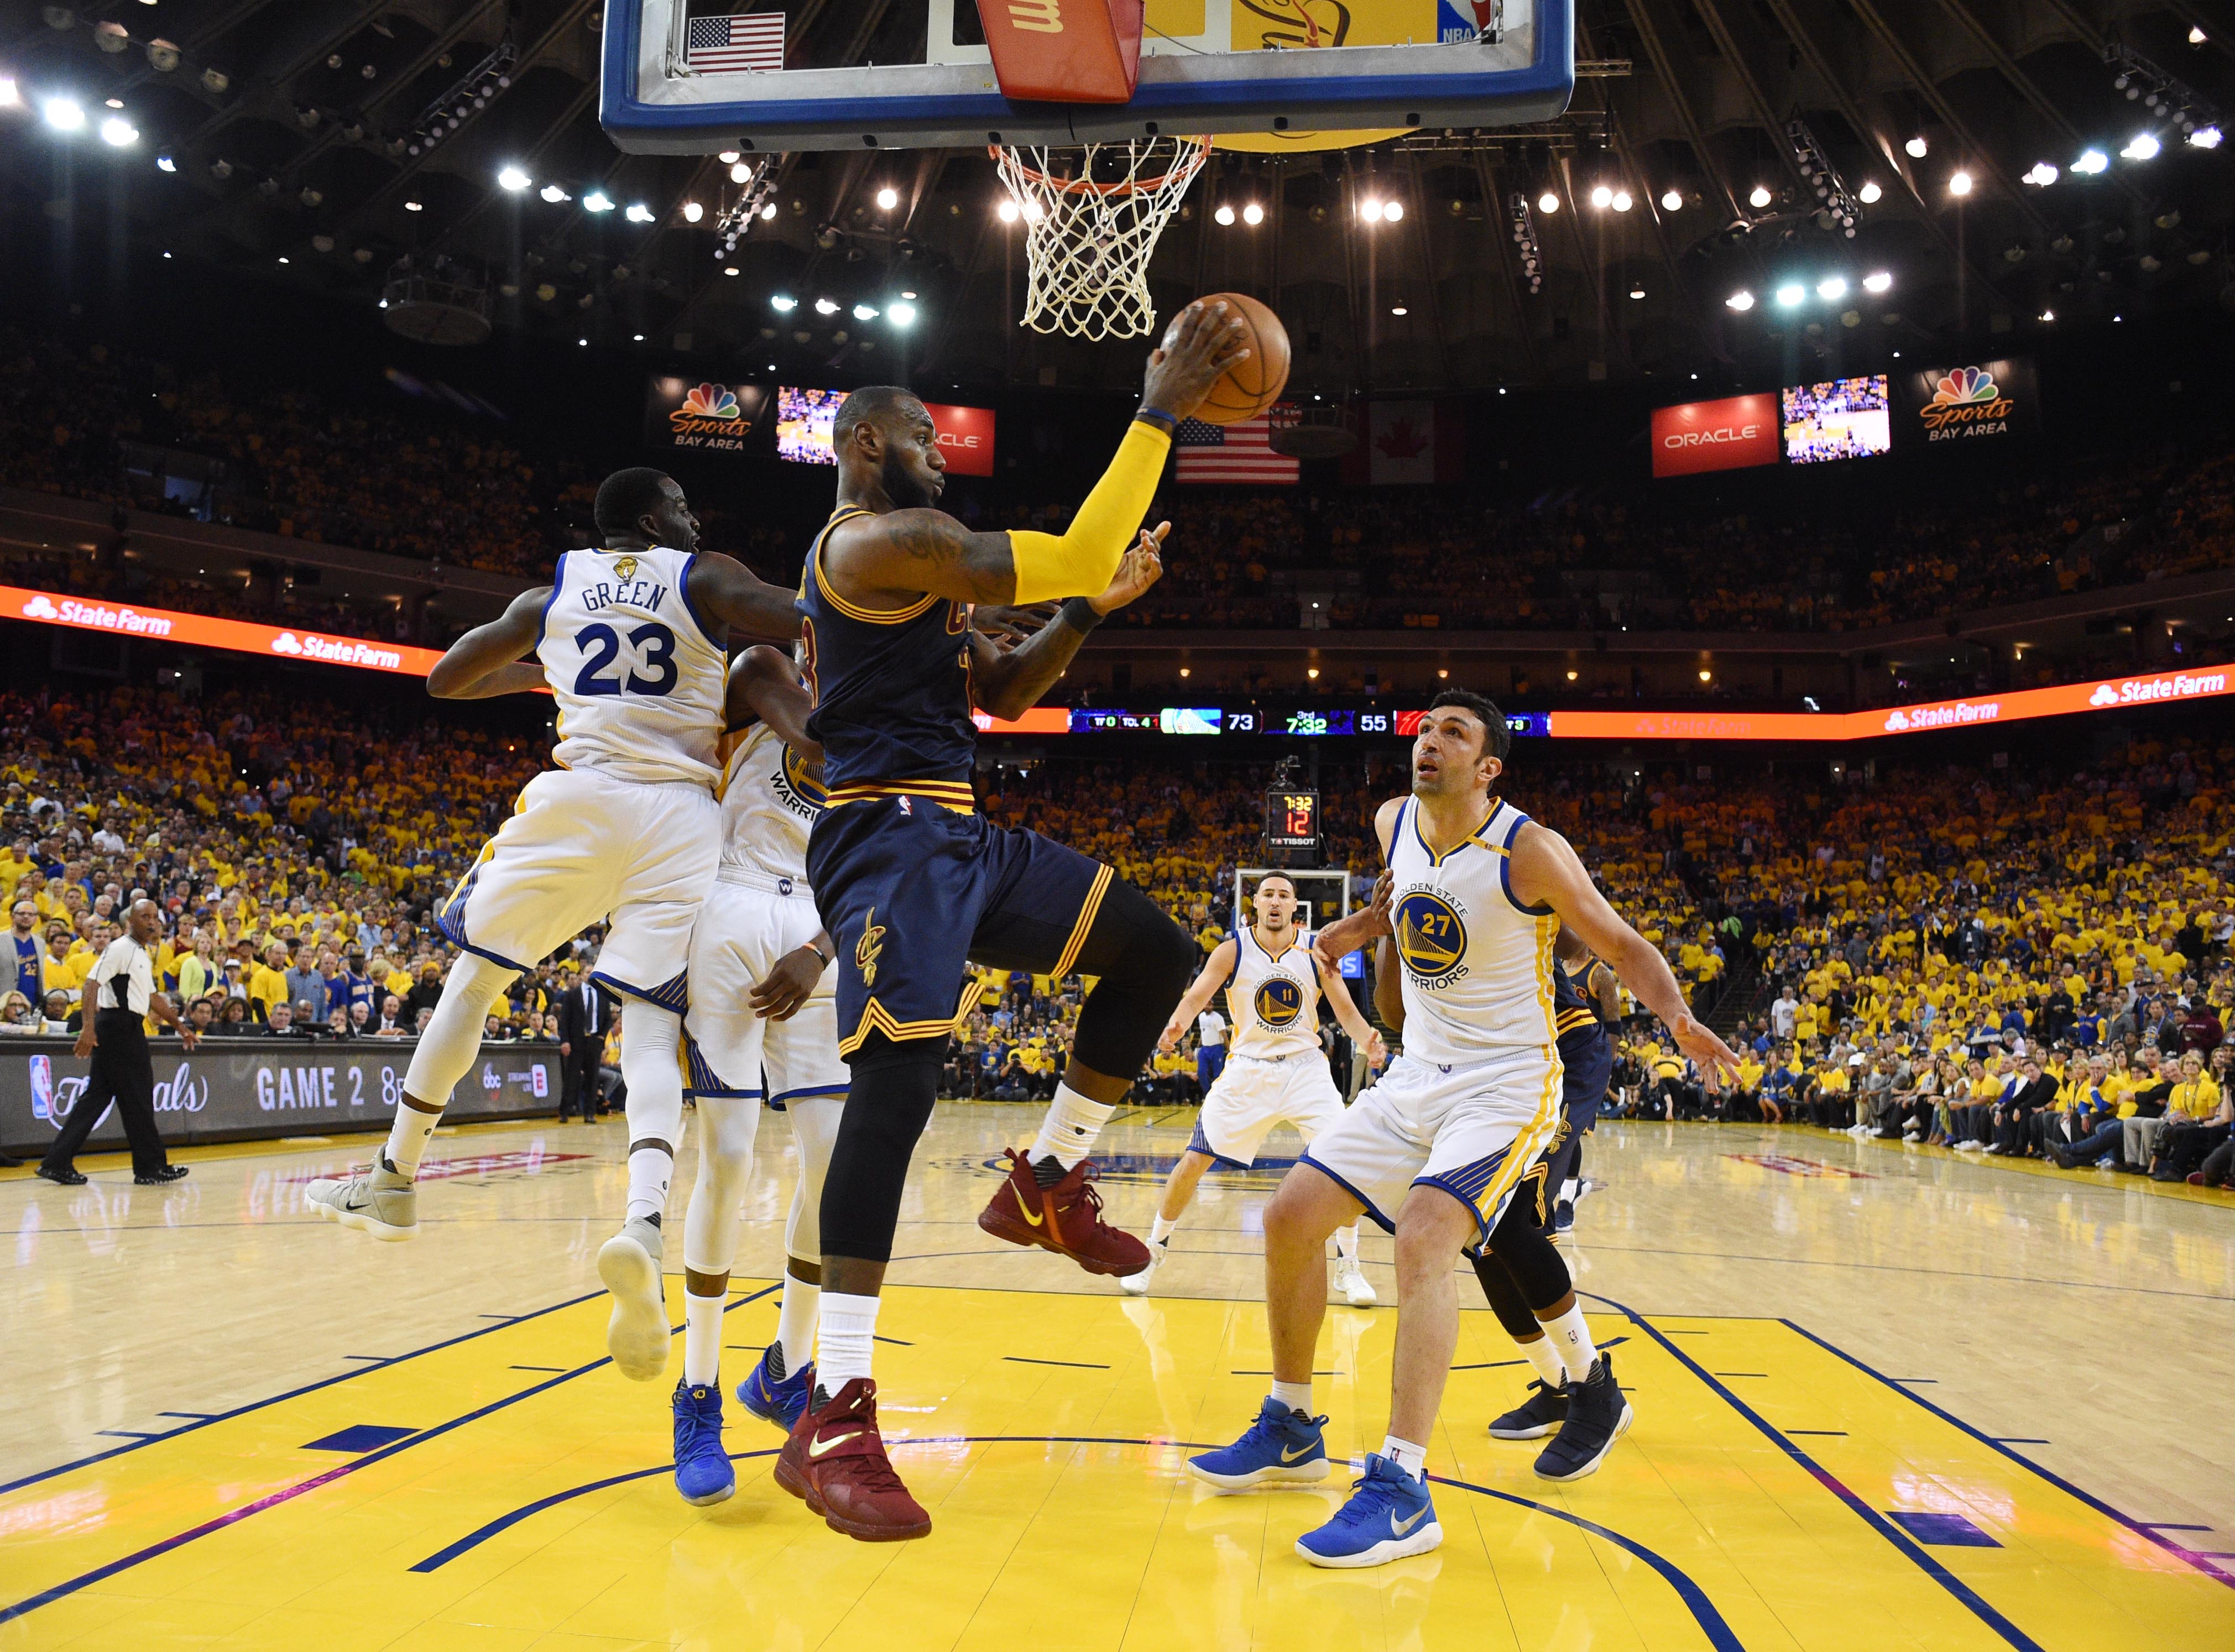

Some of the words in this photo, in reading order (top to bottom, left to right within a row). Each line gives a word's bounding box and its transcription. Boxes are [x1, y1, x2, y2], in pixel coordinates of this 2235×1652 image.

[1443, 28, 1472, 44] NBA
[669, 409, 751, 437] Sports
[1920, 397, 2013, 431] Sports
[1664, 427, 1758, 449] ORACLE
[1928, 427, 1961, 442] BAY
[1964, 420, 2007, 437] AREA
[674, 435, 704, 447] BAY
[705, 438, 744, 451] AREA
[582, 581, 668, 612] GREEN
[574, 623, 678, 697] 23
[1106, 717, 1116, 727] 0
[1228, 714, 1254, 730] 73
[1297, 710, 1315, 719] 3rd
[1360, 715, 1387, 731] 55
[1286, 718, 1327, 734] 7:32
[769, 770, 816, 822] WARRI
[1284, 796, 1313, 812] 7:32
[1287, 811, 1309, 835] 12
[1395, 882, 1433, 902] GOLDEN
[1435, 887, 1469, 917] STATE
[1421, 913, 1451, 937] 27
[1254, 973, 1281, 990] GOLDEN
[1284, 974, 1305, 988] STATE
[1401, 963, 1469, 990] ARRIORS
[1282, 989, 1292, 1001] 11
[1256, 1014, 1303, 1034] WARRIORS
[257, 1067, 338, 1111] GAME
[348, 1066, 365, 1106] 2
